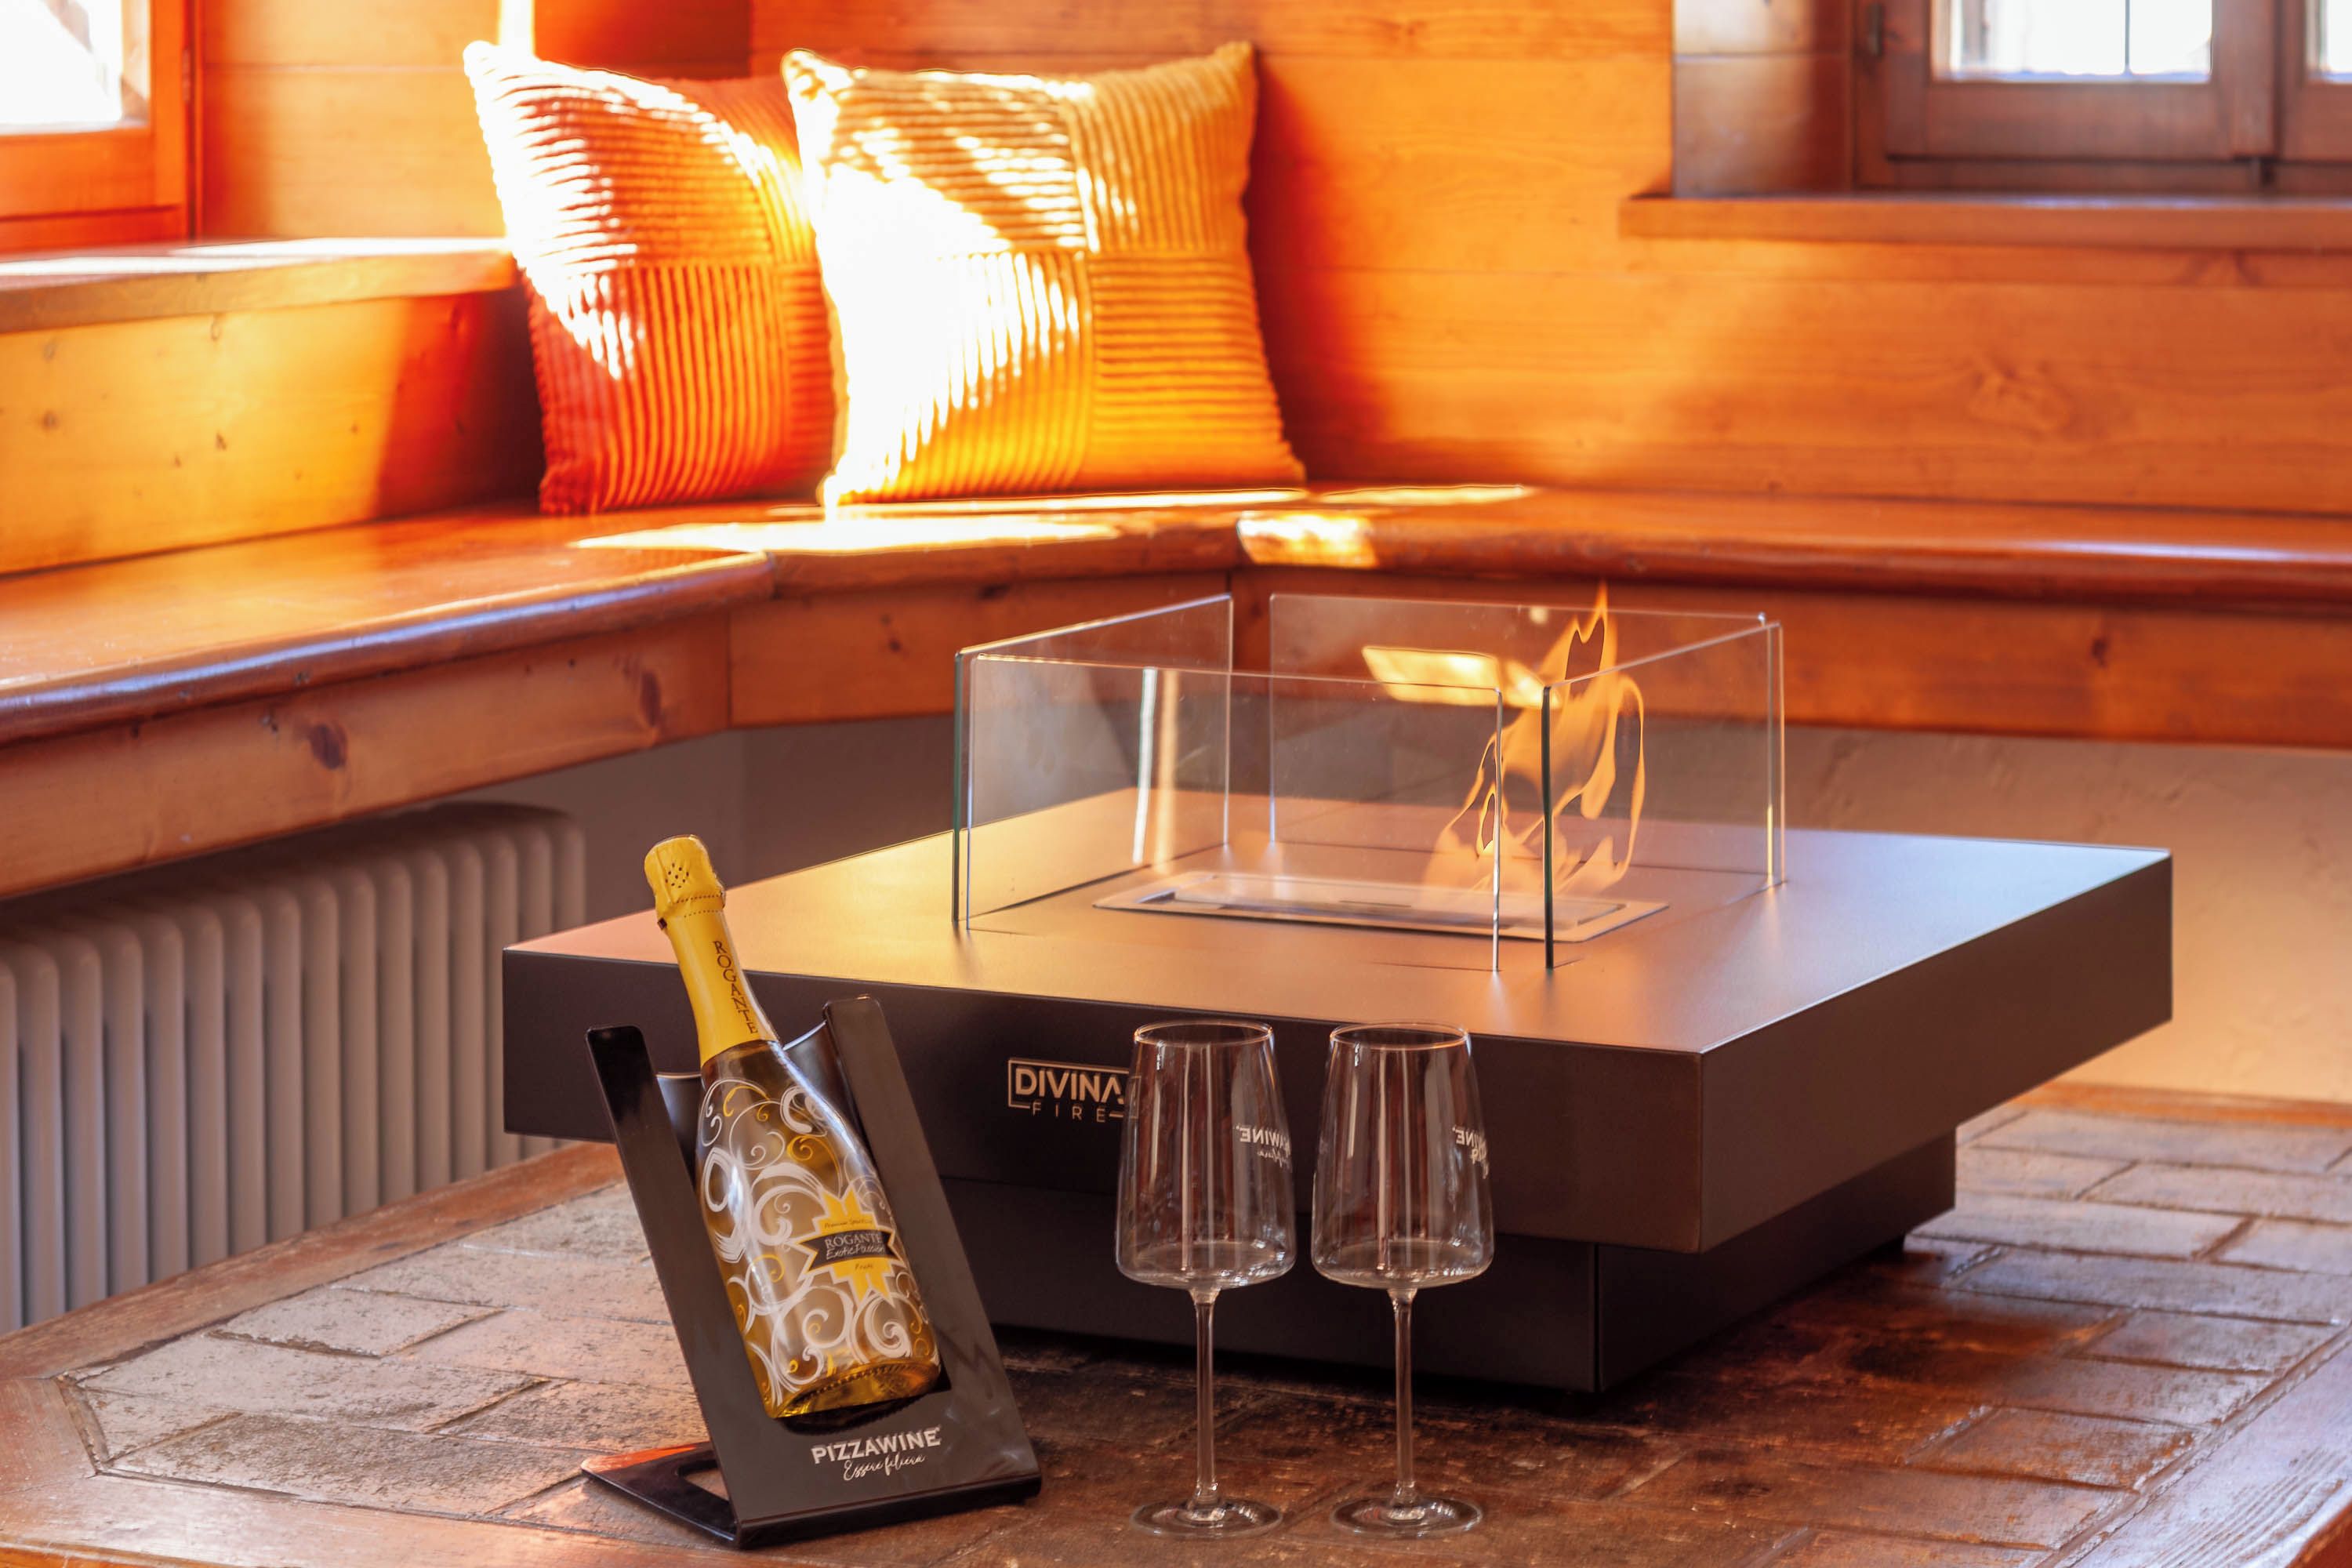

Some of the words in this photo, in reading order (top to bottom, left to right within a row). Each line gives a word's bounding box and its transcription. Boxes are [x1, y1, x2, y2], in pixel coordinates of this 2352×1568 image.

[713, 940, 758, 1034] ROGANTE
[1015, 1067, 1124, 1105] DIVINA
[1032, 1101, 1106, 1123] FIRE
[824, 1232, 883, 1250] ROGANTE
[826, 1247, 855, 1260] Exotic
[811, 1428, 941, 1464] PIZZAWINE
